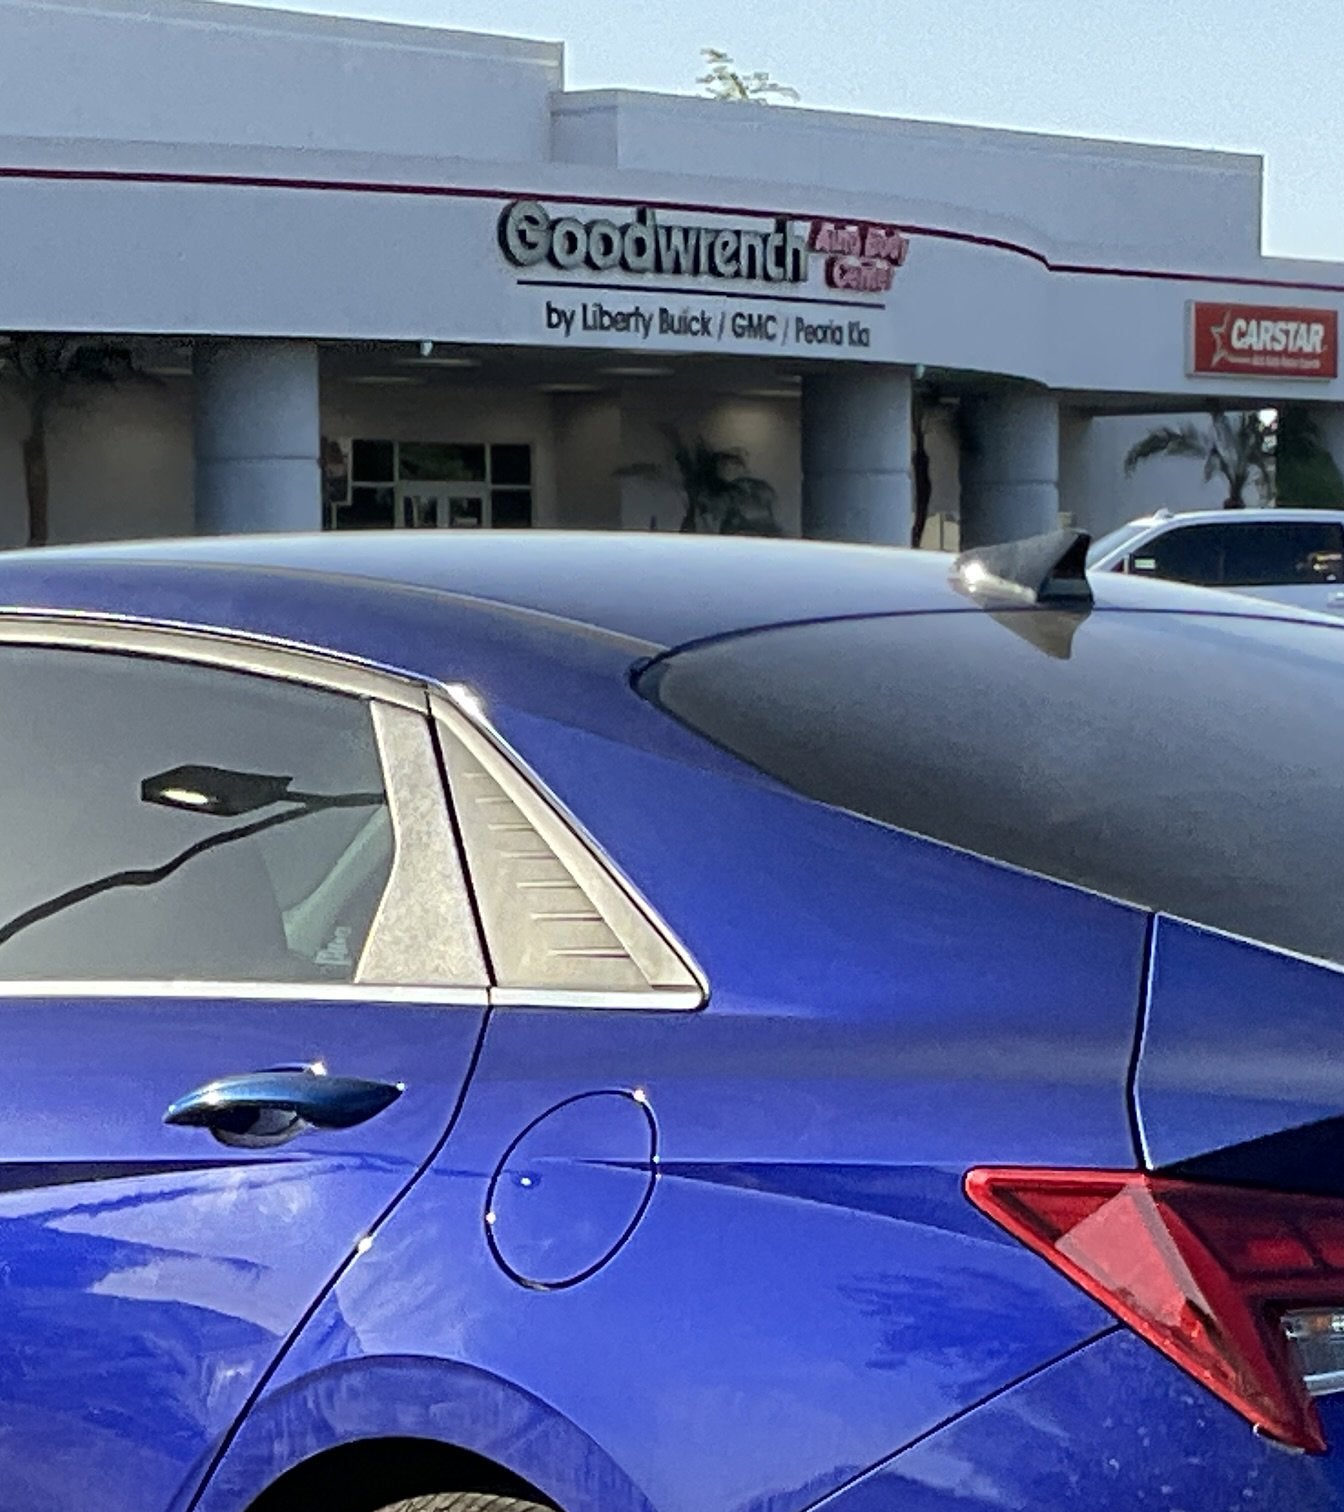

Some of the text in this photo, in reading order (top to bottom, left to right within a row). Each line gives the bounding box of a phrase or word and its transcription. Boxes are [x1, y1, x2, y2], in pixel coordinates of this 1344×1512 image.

[498, 199, 809, 283] Goodwrench
[545, 301, 576, 337] by
[581, 303, 654, 340] Liberty
[658, 306, 712, 337] Buick
[717, 310, 727, 341] /
[731, 312, 778, 341] GMC
[795, 317, 844, 346] Peoria
[847, 320, 871, 348] Kia
[1231, 318, 1325, 353] CARSTAR
